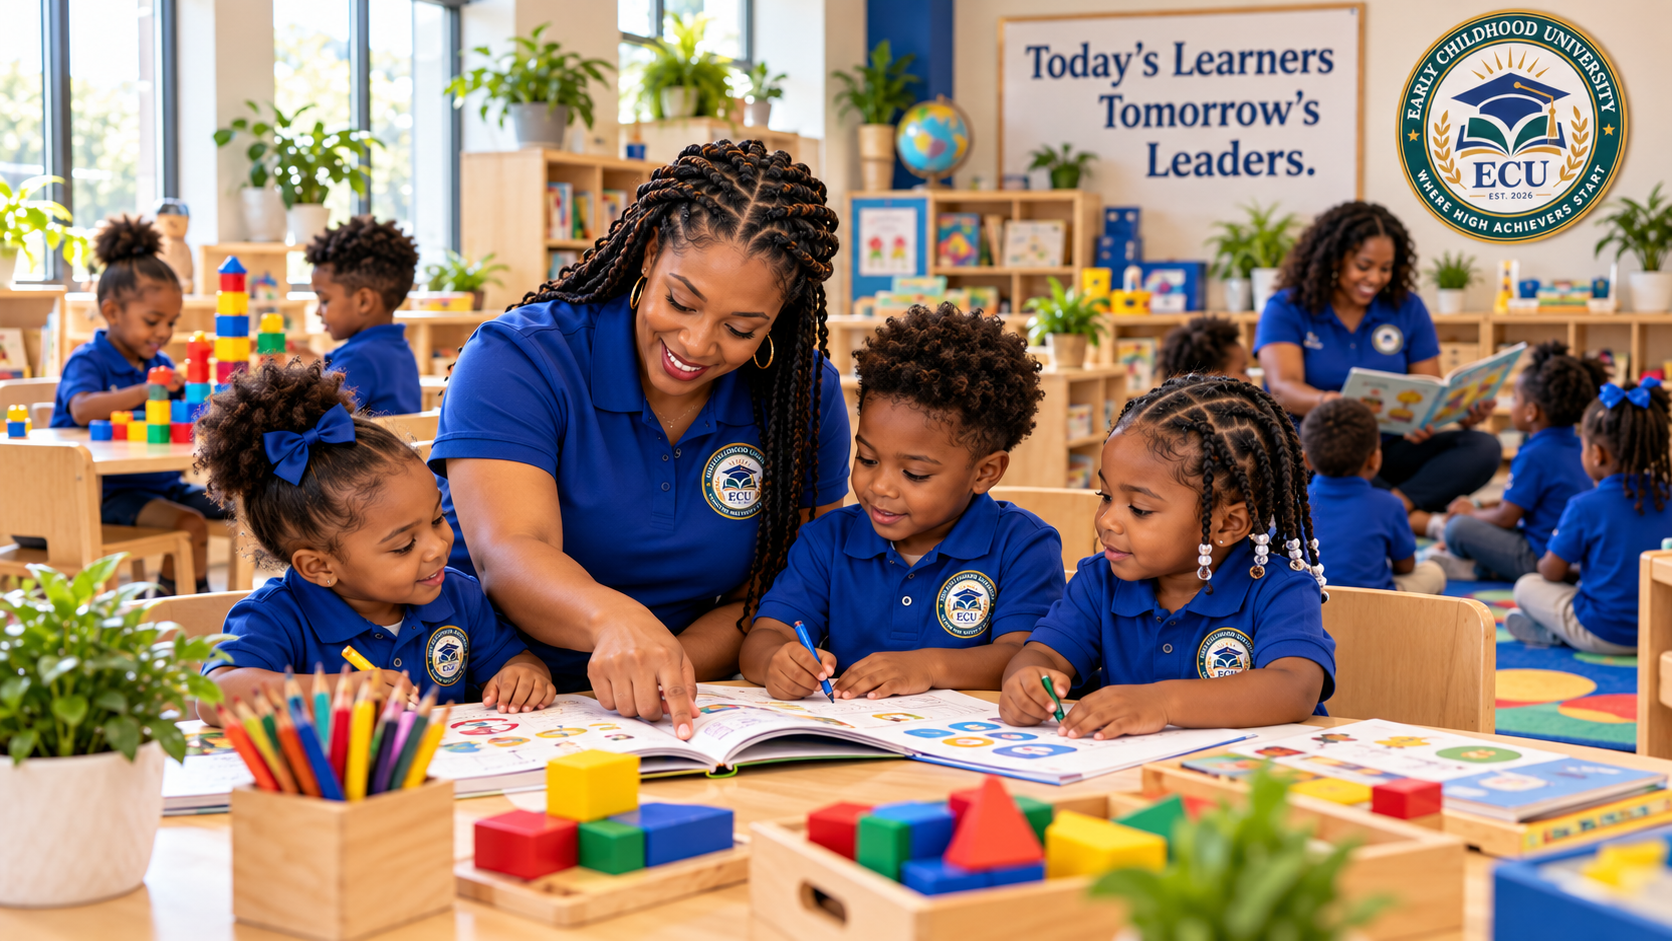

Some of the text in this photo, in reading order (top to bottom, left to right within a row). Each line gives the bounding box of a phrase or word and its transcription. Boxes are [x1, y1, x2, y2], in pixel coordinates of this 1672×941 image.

[1025, 41, 1335, 87] Today’s Learners
[1407, 20, 1616, 120] EARLY CHILDHOOD UNIVERSITY
[1099, 90, 1321, 128] Tomorrow’s
[1146, 139, 1316, 178] Leaders.
[1472, 160, 1550, 188] ECU
[1417, 164, 1606, 234] WHERE HIGH ACHIEVERS START
[1488, 191, 1533, 200] EST. 2026
[956, 612, 977, 621] ECU
